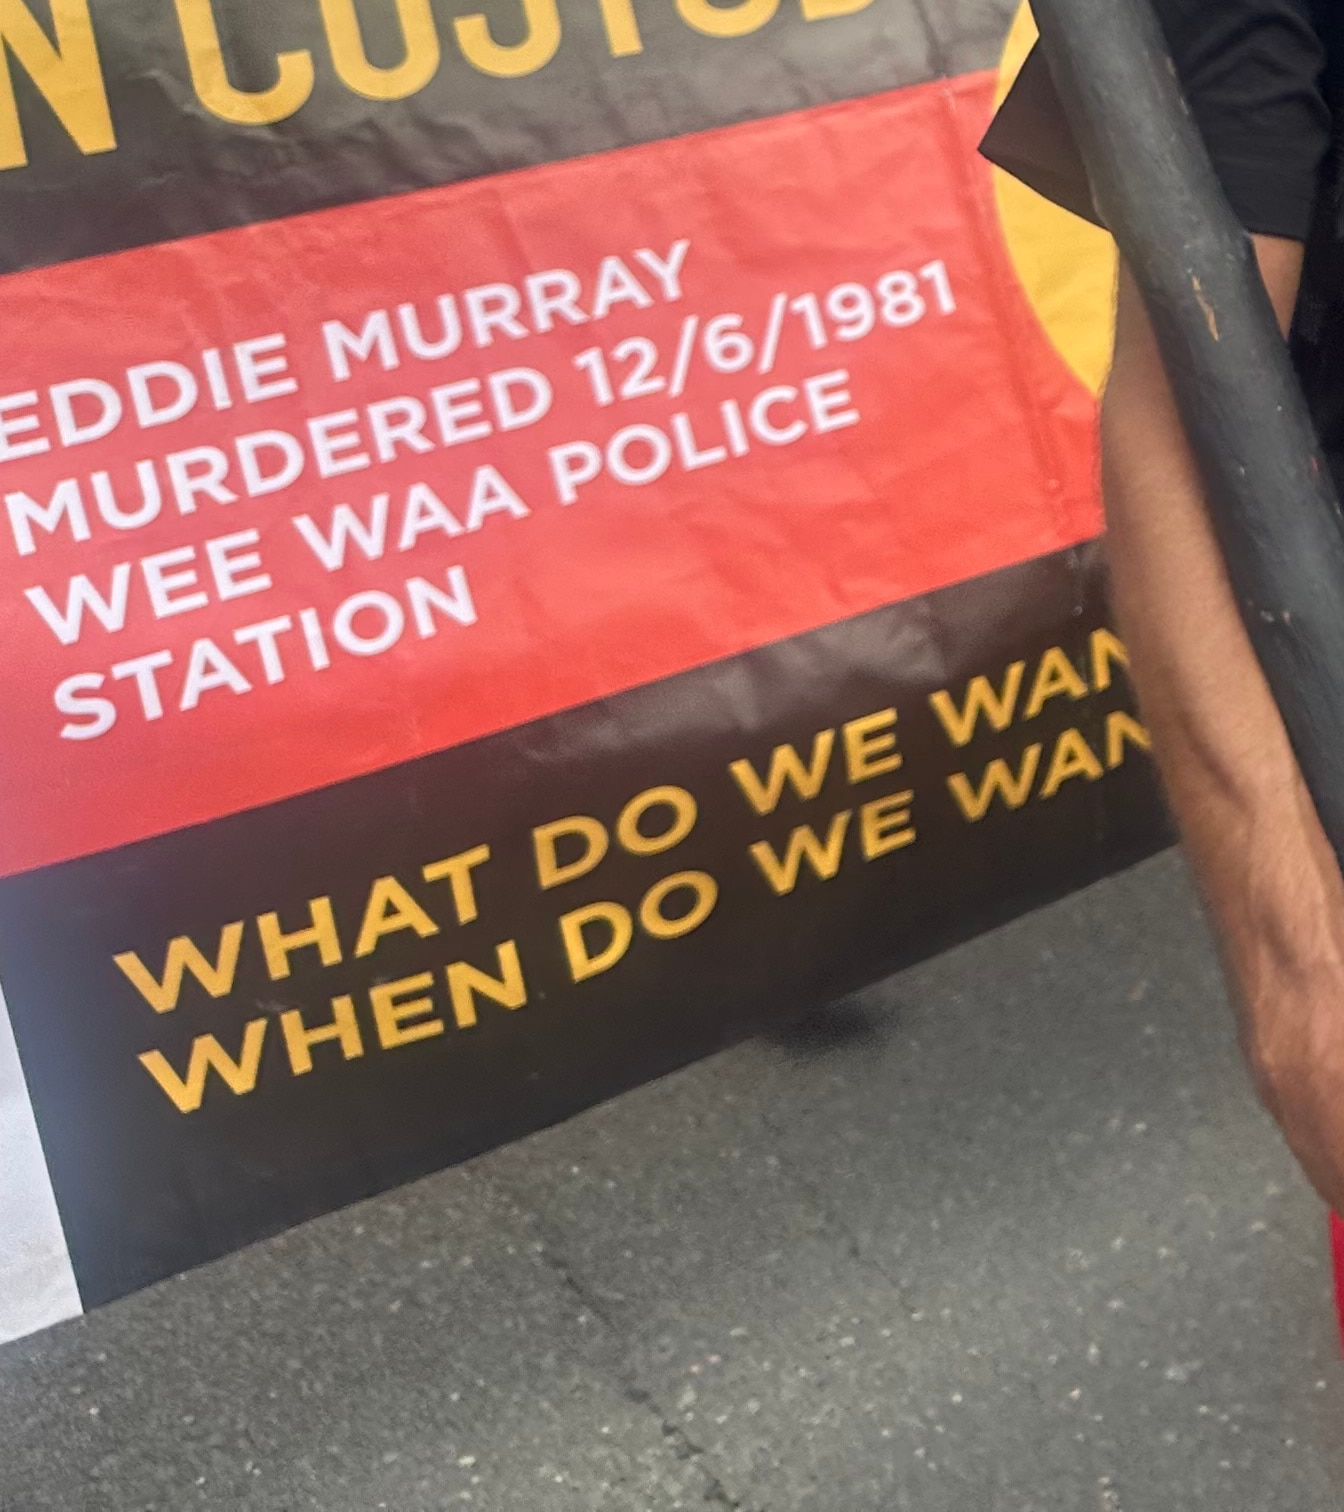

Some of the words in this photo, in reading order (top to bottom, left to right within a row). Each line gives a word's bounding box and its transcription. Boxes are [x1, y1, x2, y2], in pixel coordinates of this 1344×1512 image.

[0, 333, 298, 463] EDDIE
[322, 239, 690, 383] MURRAY
[4, 366, 554, 557] MURDERED
[574, 260, 957, 407] 12/6/1981
[24, 529, 272, 646] WEE
[293, 465, 531, 571] WAA
[547, 369, 861, 506] POLICE
[53, 565, 478, 740] STATION
[112, 844, 490, 1014] WHAT
[532, 785, 698, 890] DO
[729, 707, 903, 816] WE
[137, 940, 528, 1115] WHEN
[559, 869, 719, 983] DO
[749, 789, 917, 896] WE
